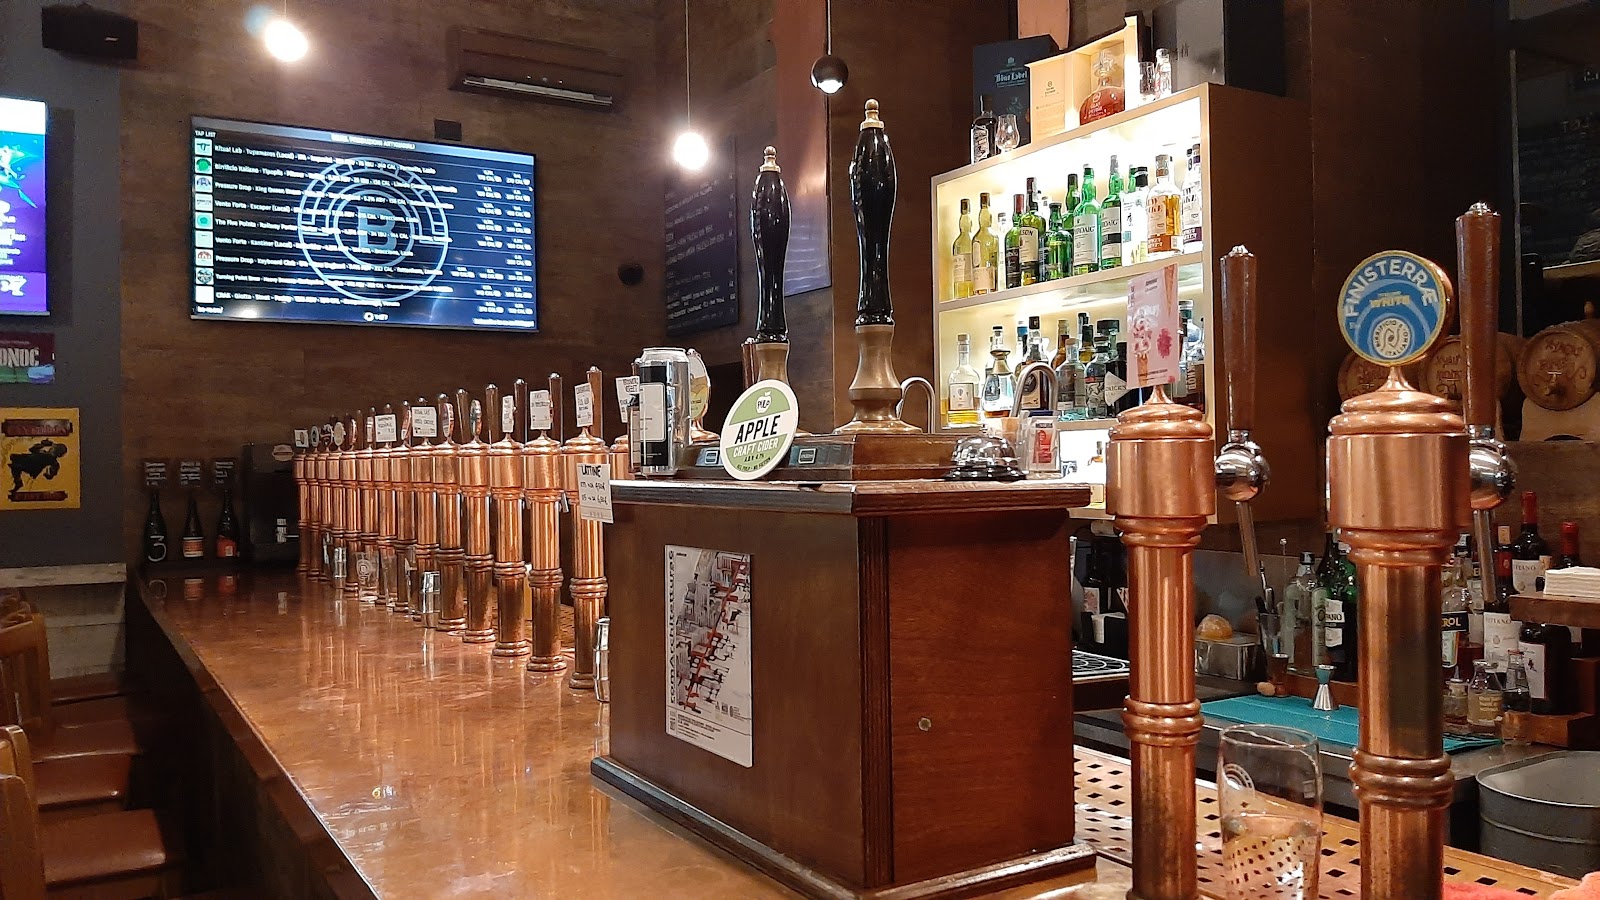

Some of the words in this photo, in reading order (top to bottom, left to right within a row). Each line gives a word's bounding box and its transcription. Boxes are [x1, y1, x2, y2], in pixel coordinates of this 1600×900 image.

[994, 73, 1010, 84] Blue
[1011, 70, 1028, 80] Label
[215, 218, 226, 226] The
[757, 399, 770, 410] PULP
[734, 414, 781, 445] APPLE
[733, 443, 757, 458] CRAFT
[756, 437, 779, 453] CIDER
